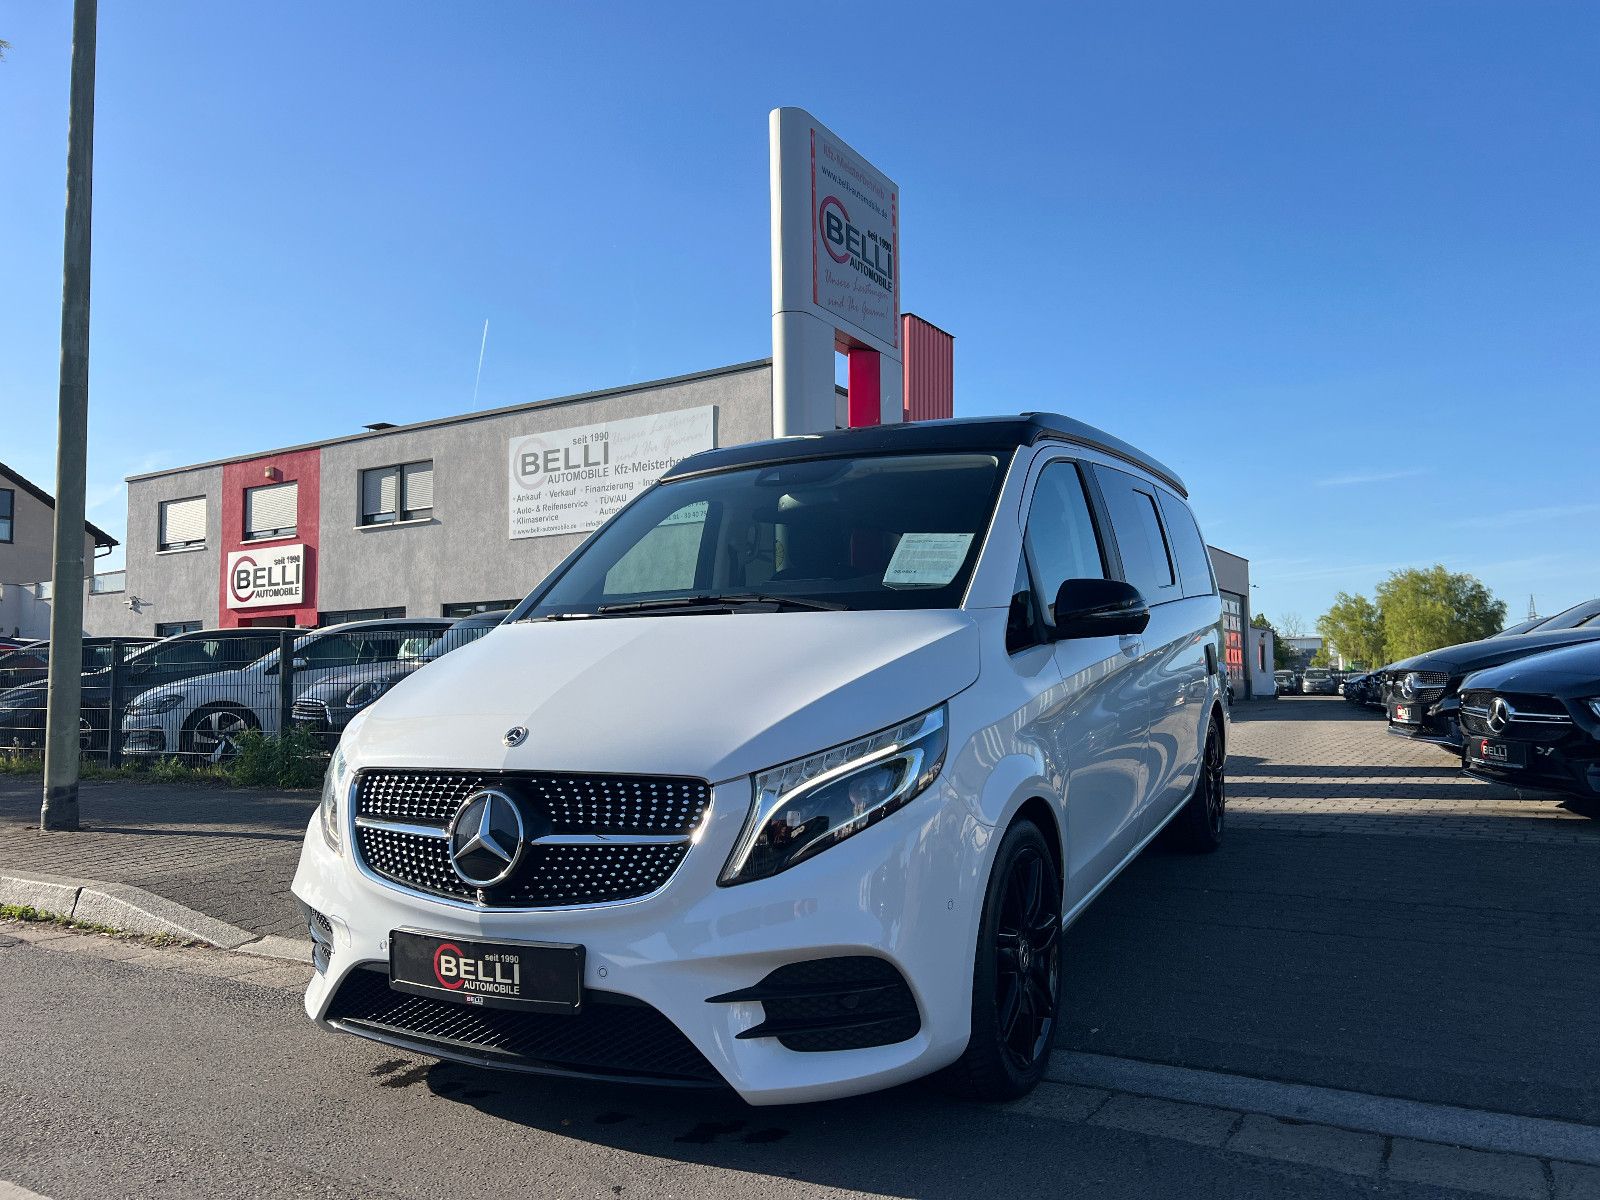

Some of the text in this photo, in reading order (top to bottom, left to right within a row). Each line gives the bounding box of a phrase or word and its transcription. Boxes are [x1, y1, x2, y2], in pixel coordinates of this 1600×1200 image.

[826, 210, 893, 280] BELLI
[867, 229, 892, 253] seit 1990
[849, 256, 893, 293] AUTOMOBILE
[572, 431, 609, 445] seit 1990
[521, 441, 609, 476] BELLI
[547, 467, 609, 485] AUTOMOBILE
[549, 487, 576, 498] Verkauf
[585, 481, 634, 494] Finanzierung
[516, 492, 542, 503] Ankauf
[516, 500, 588, 515] Auto- & Reifenservice
[516, 514, 559, 525] Klimaservice
[273, 554, 301, 566] seit 1990
[236, 563, 301, 590] BELLI
[255, 586, 300, 599] AUTOMOBILE
[1483, 745, 1507, 757] BELLI
[484, 953, 519, 964] seit 1990
[440, 955, 520, 985] BELLI
[463, 980, 520, 995] AUTOMOBILE
